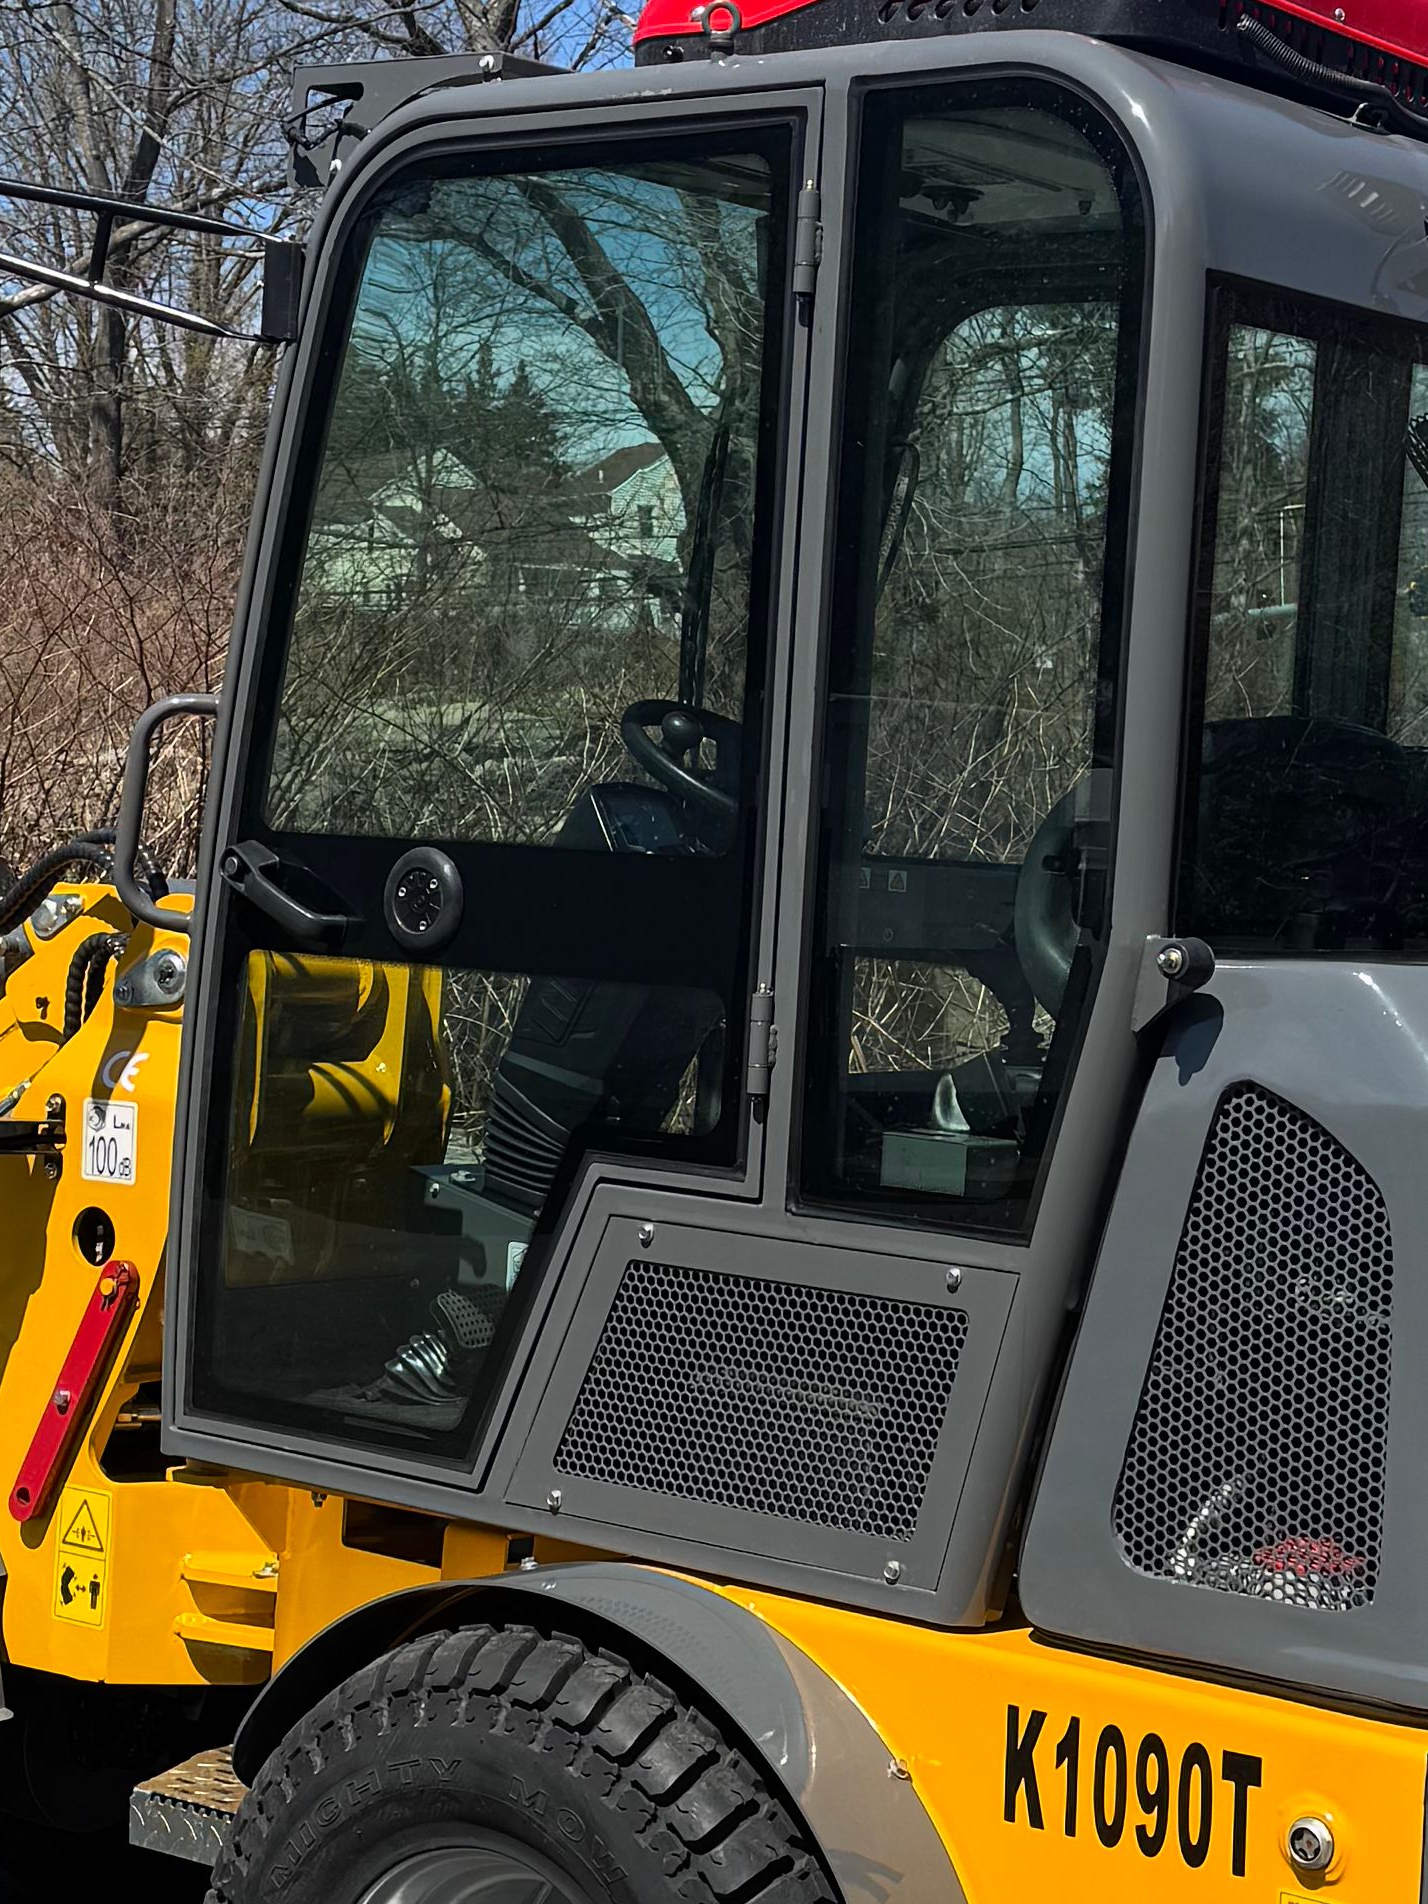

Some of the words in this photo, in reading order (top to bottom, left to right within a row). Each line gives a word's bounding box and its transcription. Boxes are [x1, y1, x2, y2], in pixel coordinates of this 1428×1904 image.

[88, 1134, 118, 1177] 100
[507, 1773, 631, 1892] MOW
[1003, 1703, 1263, 1878] K1090T
